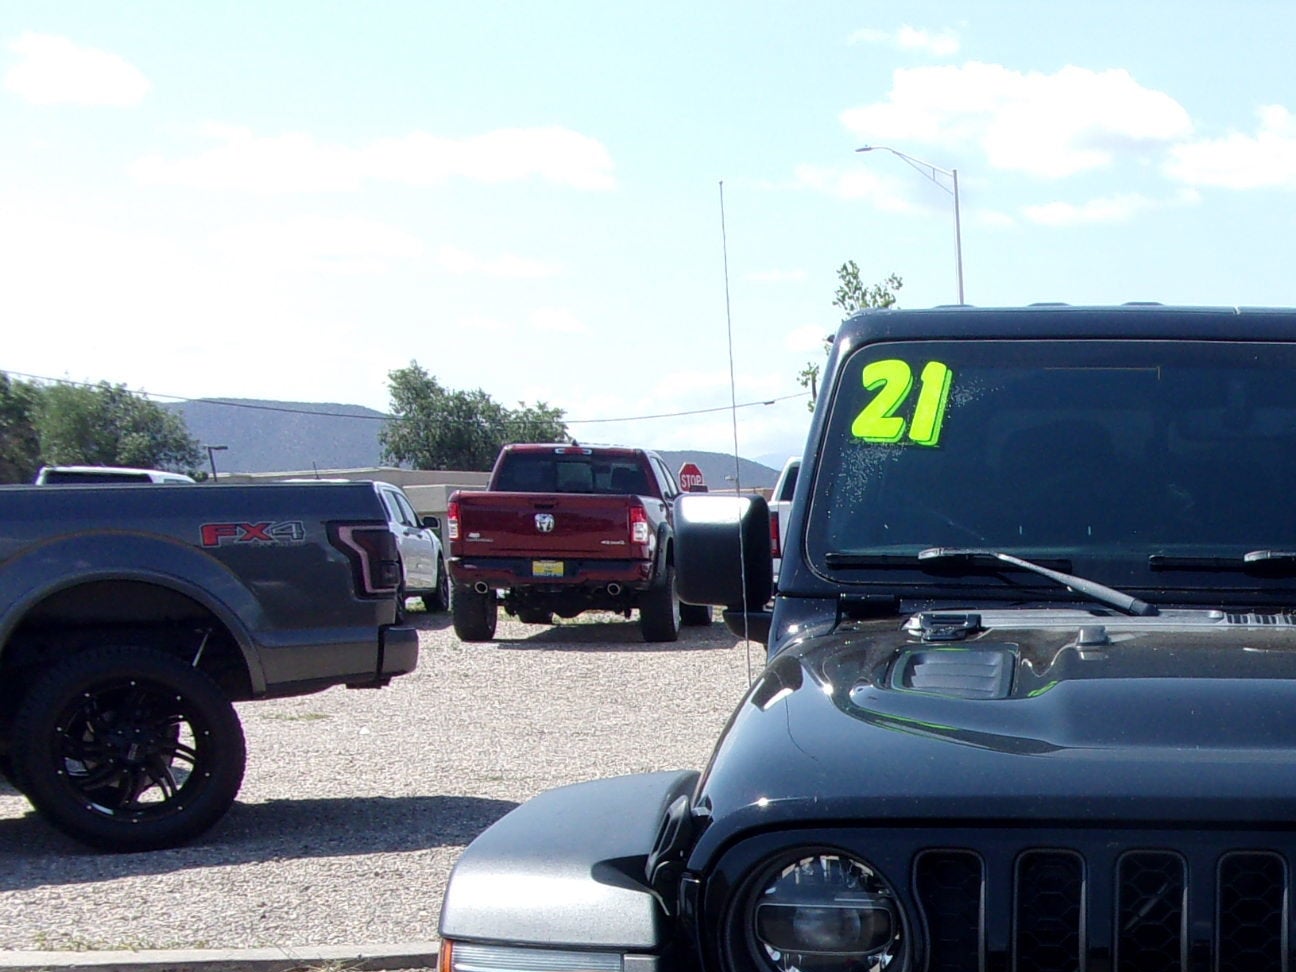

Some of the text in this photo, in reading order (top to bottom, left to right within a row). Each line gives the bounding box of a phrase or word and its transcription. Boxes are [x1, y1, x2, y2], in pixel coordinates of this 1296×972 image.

[852, 359, 952, 445] 21
[681, 474, 701, 488] STOP
[200, 520, 304, 547] FX4
